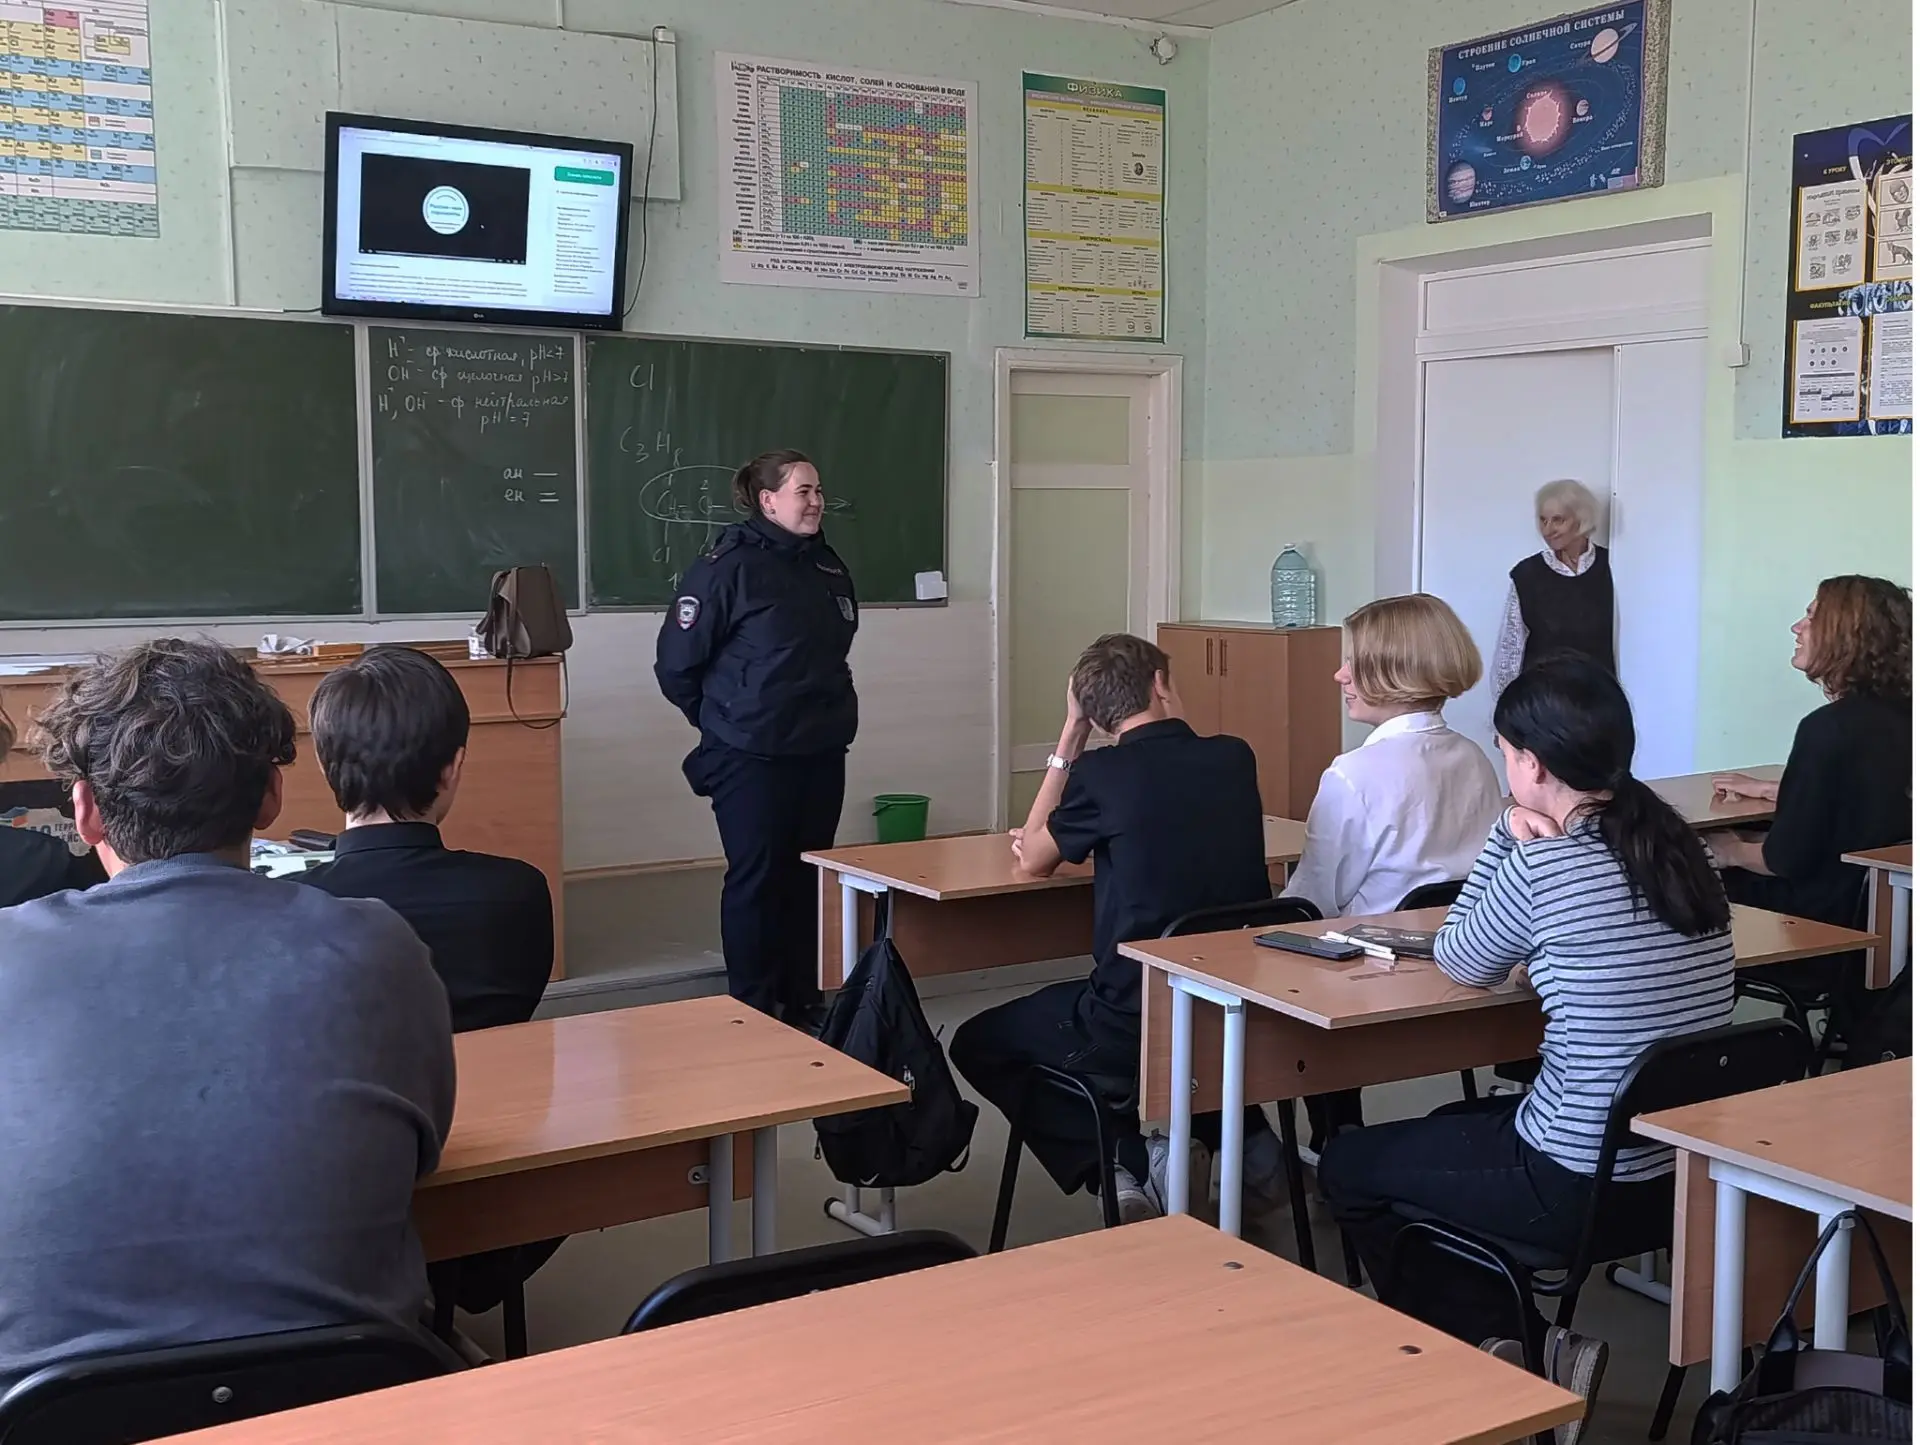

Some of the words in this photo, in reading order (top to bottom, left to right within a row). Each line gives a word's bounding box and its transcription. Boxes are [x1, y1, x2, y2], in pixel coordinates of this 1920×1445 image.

[1510, 23, 1570, 47] СОЛНЕЧНОЙ
[1574, 9, 1625, 31] СИСТЕМЫ
[1067, 82, 1123, 98] ФИЗИКА
